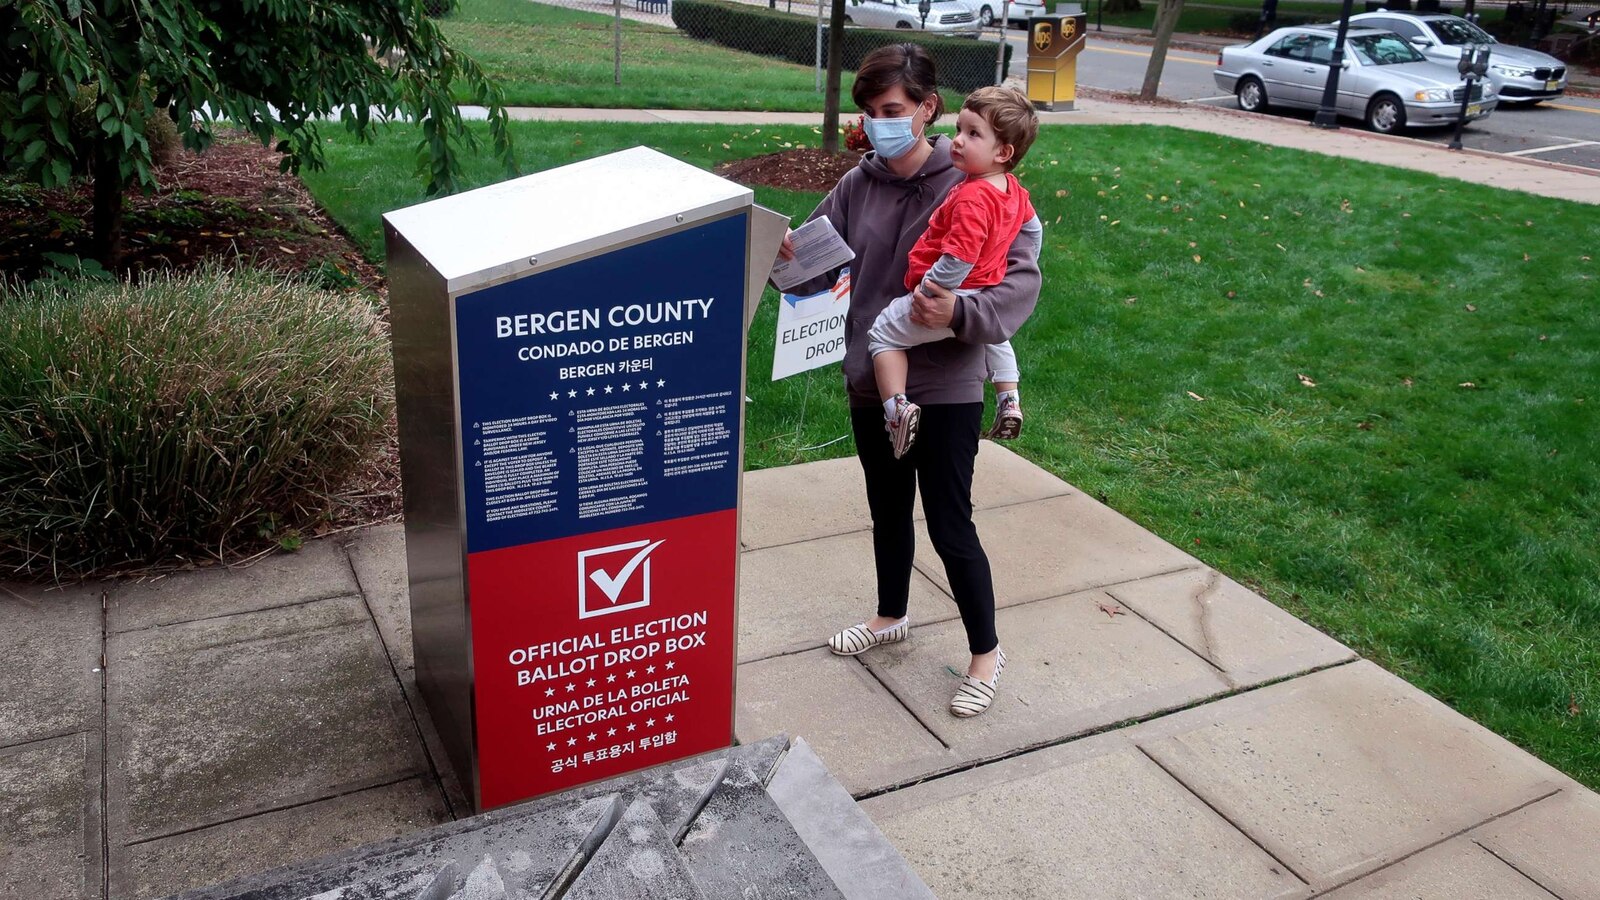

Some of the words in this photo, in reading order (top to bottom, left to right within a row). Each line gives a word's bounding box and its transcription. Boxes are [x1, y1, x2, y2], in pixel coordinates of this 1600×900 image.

[496, 308, 600, 338] BERGEN
[608, 298, 714, 327] COUNTY
[518, 340, 604, 361] CONDADO
[609, 338, 629, 352] DE
[634, 330, 694, 349] BERGEN
[806, 336, 844, 360] DROP
[560, 362, 615, 380] BERGEN
[618, 358, 653, 374] 카운티
[508, 633, 606, 666] OFFICIAL
[611, 610, 708, 644] ELECTION
[518, 654, 599, 686] BALLOT
[604, 642, 660, 667] DROP
[666, 632, 706, 654] BOX
[532, 700, 580, 720] URNA
[584, 694, 604, 709] DE
[608, 689, 628, 703] LA
[631, 674, 690, 698] BOLETA
[537, 704, 627, 736] ELECTORAL
[630, 690, 690, 713] OFICIAL
[550, 755, 578, 773] 공식
[582, 741, 635, 765] 투표용지
[638, 730, 678, 750] 투입함
